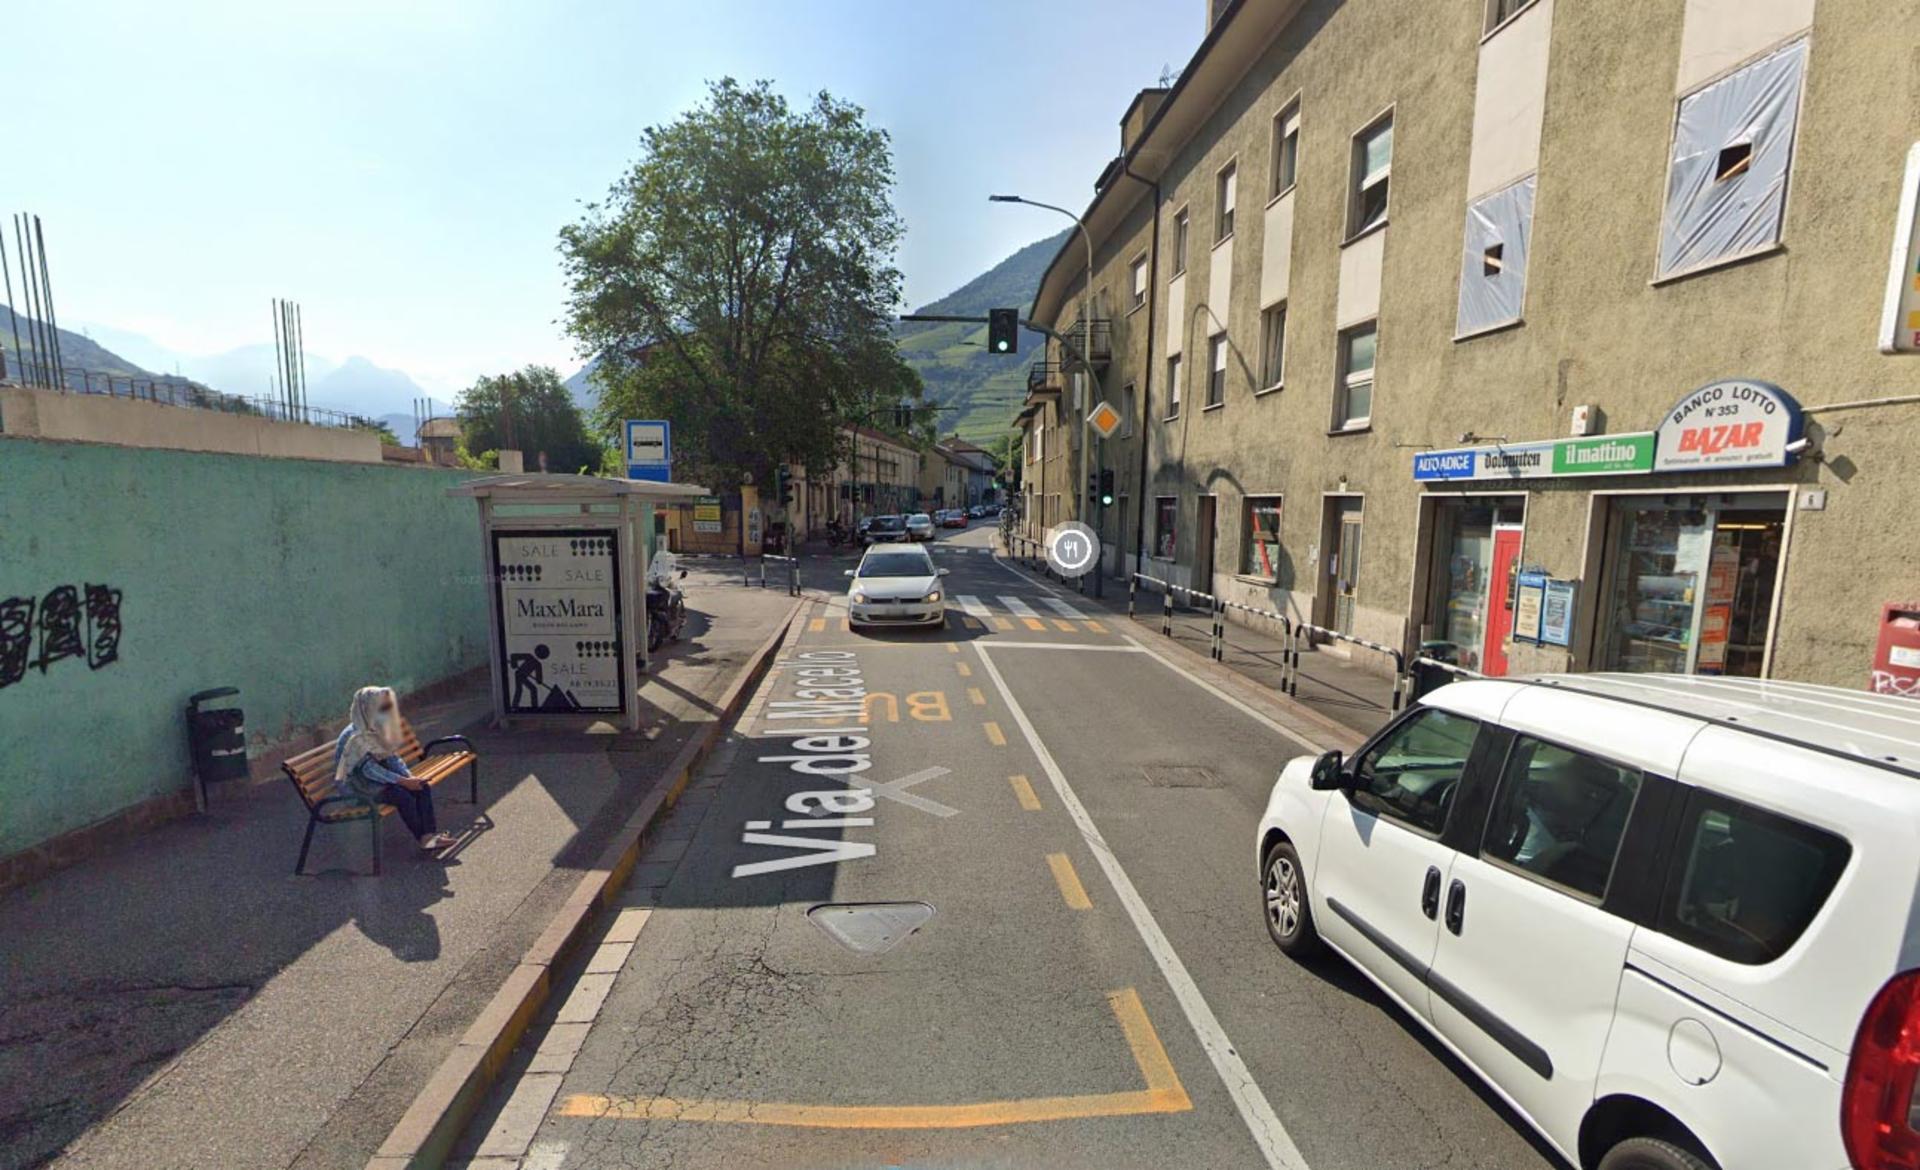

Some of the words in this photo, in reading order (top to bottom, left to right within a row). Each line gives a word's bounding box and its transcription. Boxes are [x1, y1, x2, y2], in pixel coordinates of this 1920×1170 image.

[1673, 387, 1723, 424] BANCO
[1732, 386, 1776, 415] LOTTO
[1717, 404, 1740, 417] 353
[1678, 421, 1764, 454] BAZAR
[1566, 444, 1576, 464] il
[1577, 441, 1636, 464] mattino
[1440, 455, 1470, 470] ADIGE
[1808, 494, 1815, 506] 6
[521, 545, 559, 558] SALE
[565, 570, 604, 582] SALE
[517, 598, 605, 618] MaxMara
[551, 662, 588, 675] SALE
